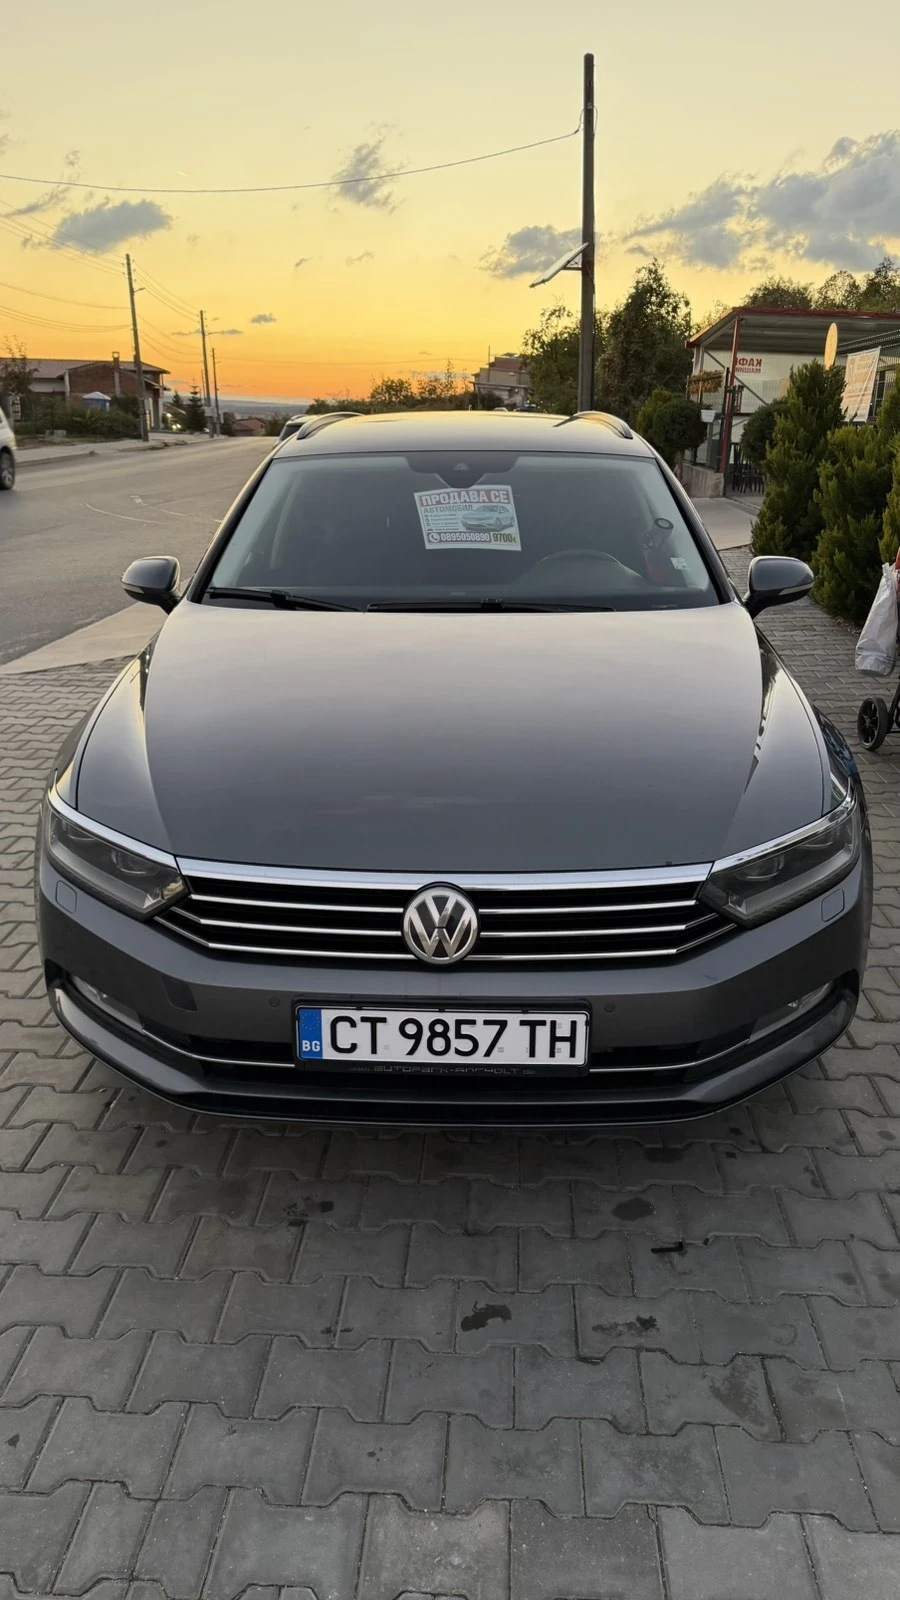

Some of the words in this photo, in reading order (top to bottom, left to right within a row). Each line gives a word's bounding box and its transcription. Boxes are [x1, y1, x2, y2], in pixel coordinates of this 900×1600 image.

[421, 490, 488, 506] ПРОДАВА
[490, 490, 509, 503] СЕ
[423, 504, 474, 514] АВТОМОБИЛ
[404, 886, 478, 964] VW
[329, 1015, 387, 1055] CT
[398, 1017, 508, 1057] 9857
[519, 1019, 578, 1058] TH
[301, 1040, 321, 1052] BG
